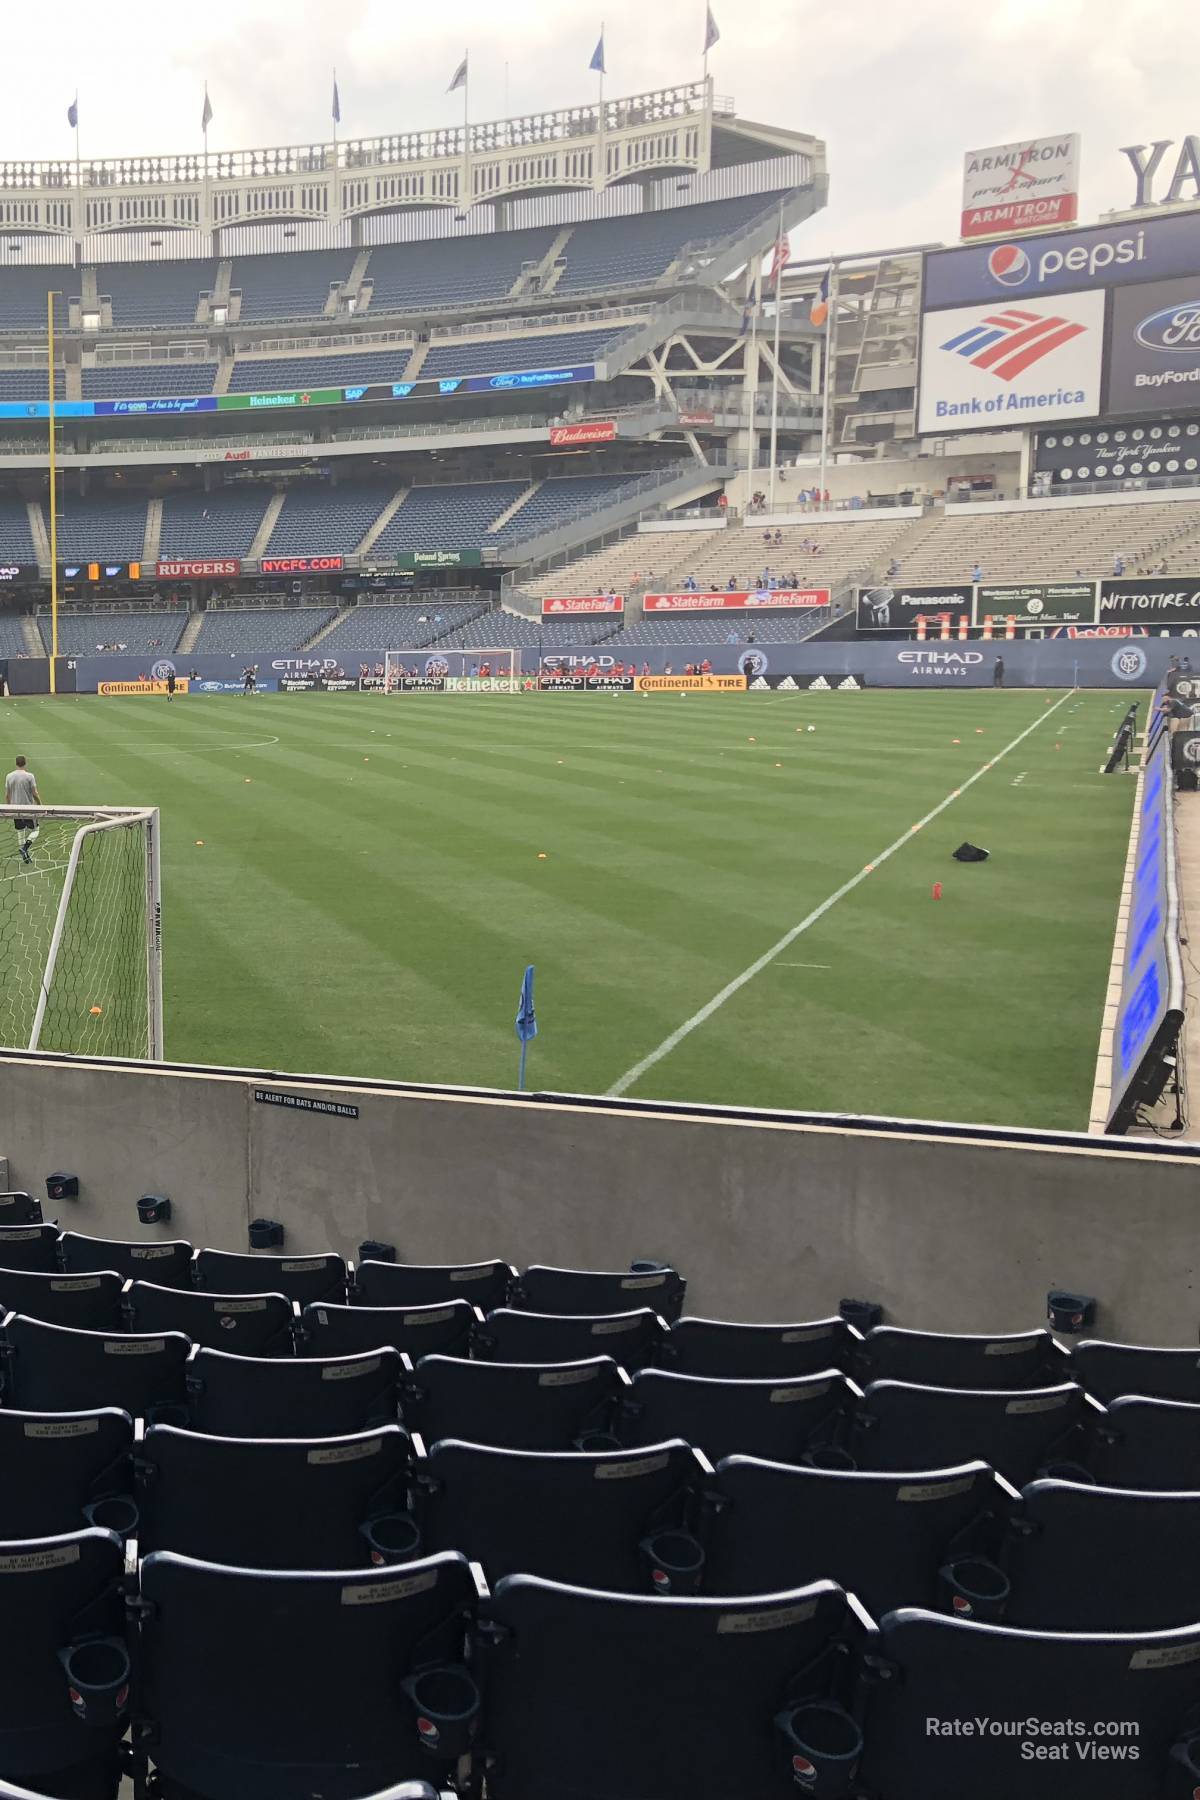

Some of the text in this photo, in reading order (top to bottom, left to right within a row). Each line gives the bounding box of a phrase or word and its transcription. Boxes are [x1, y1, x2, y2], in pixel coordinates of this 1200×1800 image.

[967, 143, 1071, 174] ARMITRON
[969, 199, 1063, 225] ARMITRON
[1039, 231, 1145, 282] pepsi
[392, 385, 410, 397] SAP
[439, 381, 458, 393] SAP
[345, 388, 363, 400] SAP
[249, 395, 296, 407] Heineken
[936, 388, 1085, 418] Bank of America
[551, 426, 614, 444] Budweiser
[225, 450, 250, 461] Audi
[1096, 442, 1181, 461] New York Yankees
[159, 562, 236, 576] RUTGERS
[262, 558, 341, 572] NYCFC.COM
[901, 593, 965, 606] Panasonic
[543, 656, 615, 667] ETIHAD
[897, 652, 984, 664] ETIHAD
[271, 659, 337, 670] ETIHAD
[912, 666, 967, 676] AIRWAYS
[405, 677, 442, 686] ETIHAD
[447, 677, 520, 693] Heineken
[541, 677, 583, 685] ETIHAD
[588, 677, 632, 685] ETIHAD
[638, 676, 743, 691] Continental TIRE
[101, 682, 185, 693] Continental TRE
[256, 1092, 357, 1116] BE ALERT FOR BATS AND/OR BALLS
